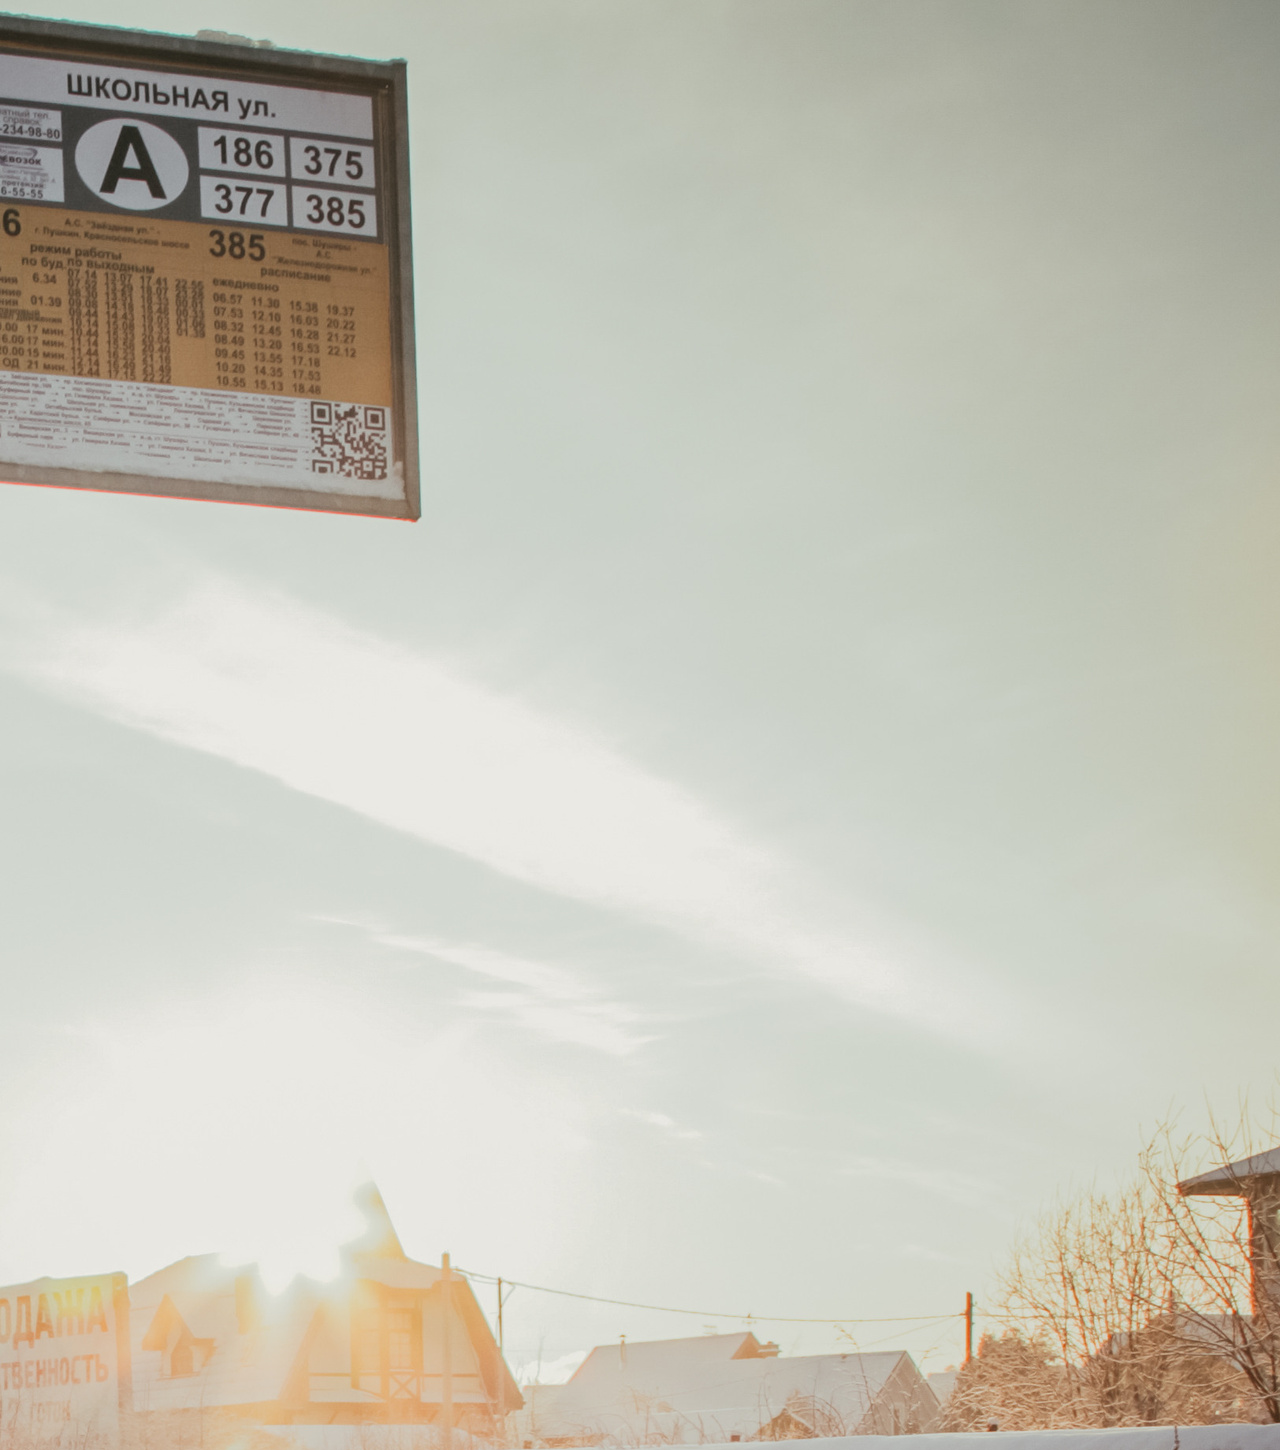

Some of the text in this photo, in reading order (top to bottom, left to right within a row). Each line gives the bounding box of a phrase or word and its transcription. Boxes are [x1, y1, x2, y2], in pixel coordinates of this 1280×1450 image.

[67, 73, 276, 123] ШКОЛЬНАЯ ул.
[98, 121, 166, 199] А
[213, 134, 273, 169] 186
[303, 145, 363, 179] 375
[214, 183, 274, 218] 377
[305, 193, 365, 228] 385
[30, 243, 121, 261] режим работы
[208, 229, 265, 262] 385
[21, 257, 37, 266] по
[67, 258, 154, 275] по выходным
[32, 271, 56, 284] 6.34
[212, 277, 279, 293] ежедневно
[260, 266, 331, 284] расписание
[30, 294, 61, 307] 01.39
[213, 292, 354, 316] 06.57 11.30 15.38 19.37
[213, 305, 355, 330] 07.53 12.10 16.03 20.22
[26, 323, 38, 333] 17
[213, 319, 356, 344] 08.32 12.45 16.28 21.27
[26, 335, 38, 345] 17
[214, 333, 356, 357] 08.49 13.20 16.53 22.12
[27, 347, 39, 357] 15
[214, 347, 320, 367] 09.45 13.55 17.18
[2, 357, 19, 368] ОД
[27, 359, 38, 369] 21
[216, 361, 321, 381] 10.20 14.35 17.53
[217, 375, 321, 395] 10.55 15.13 18.48
